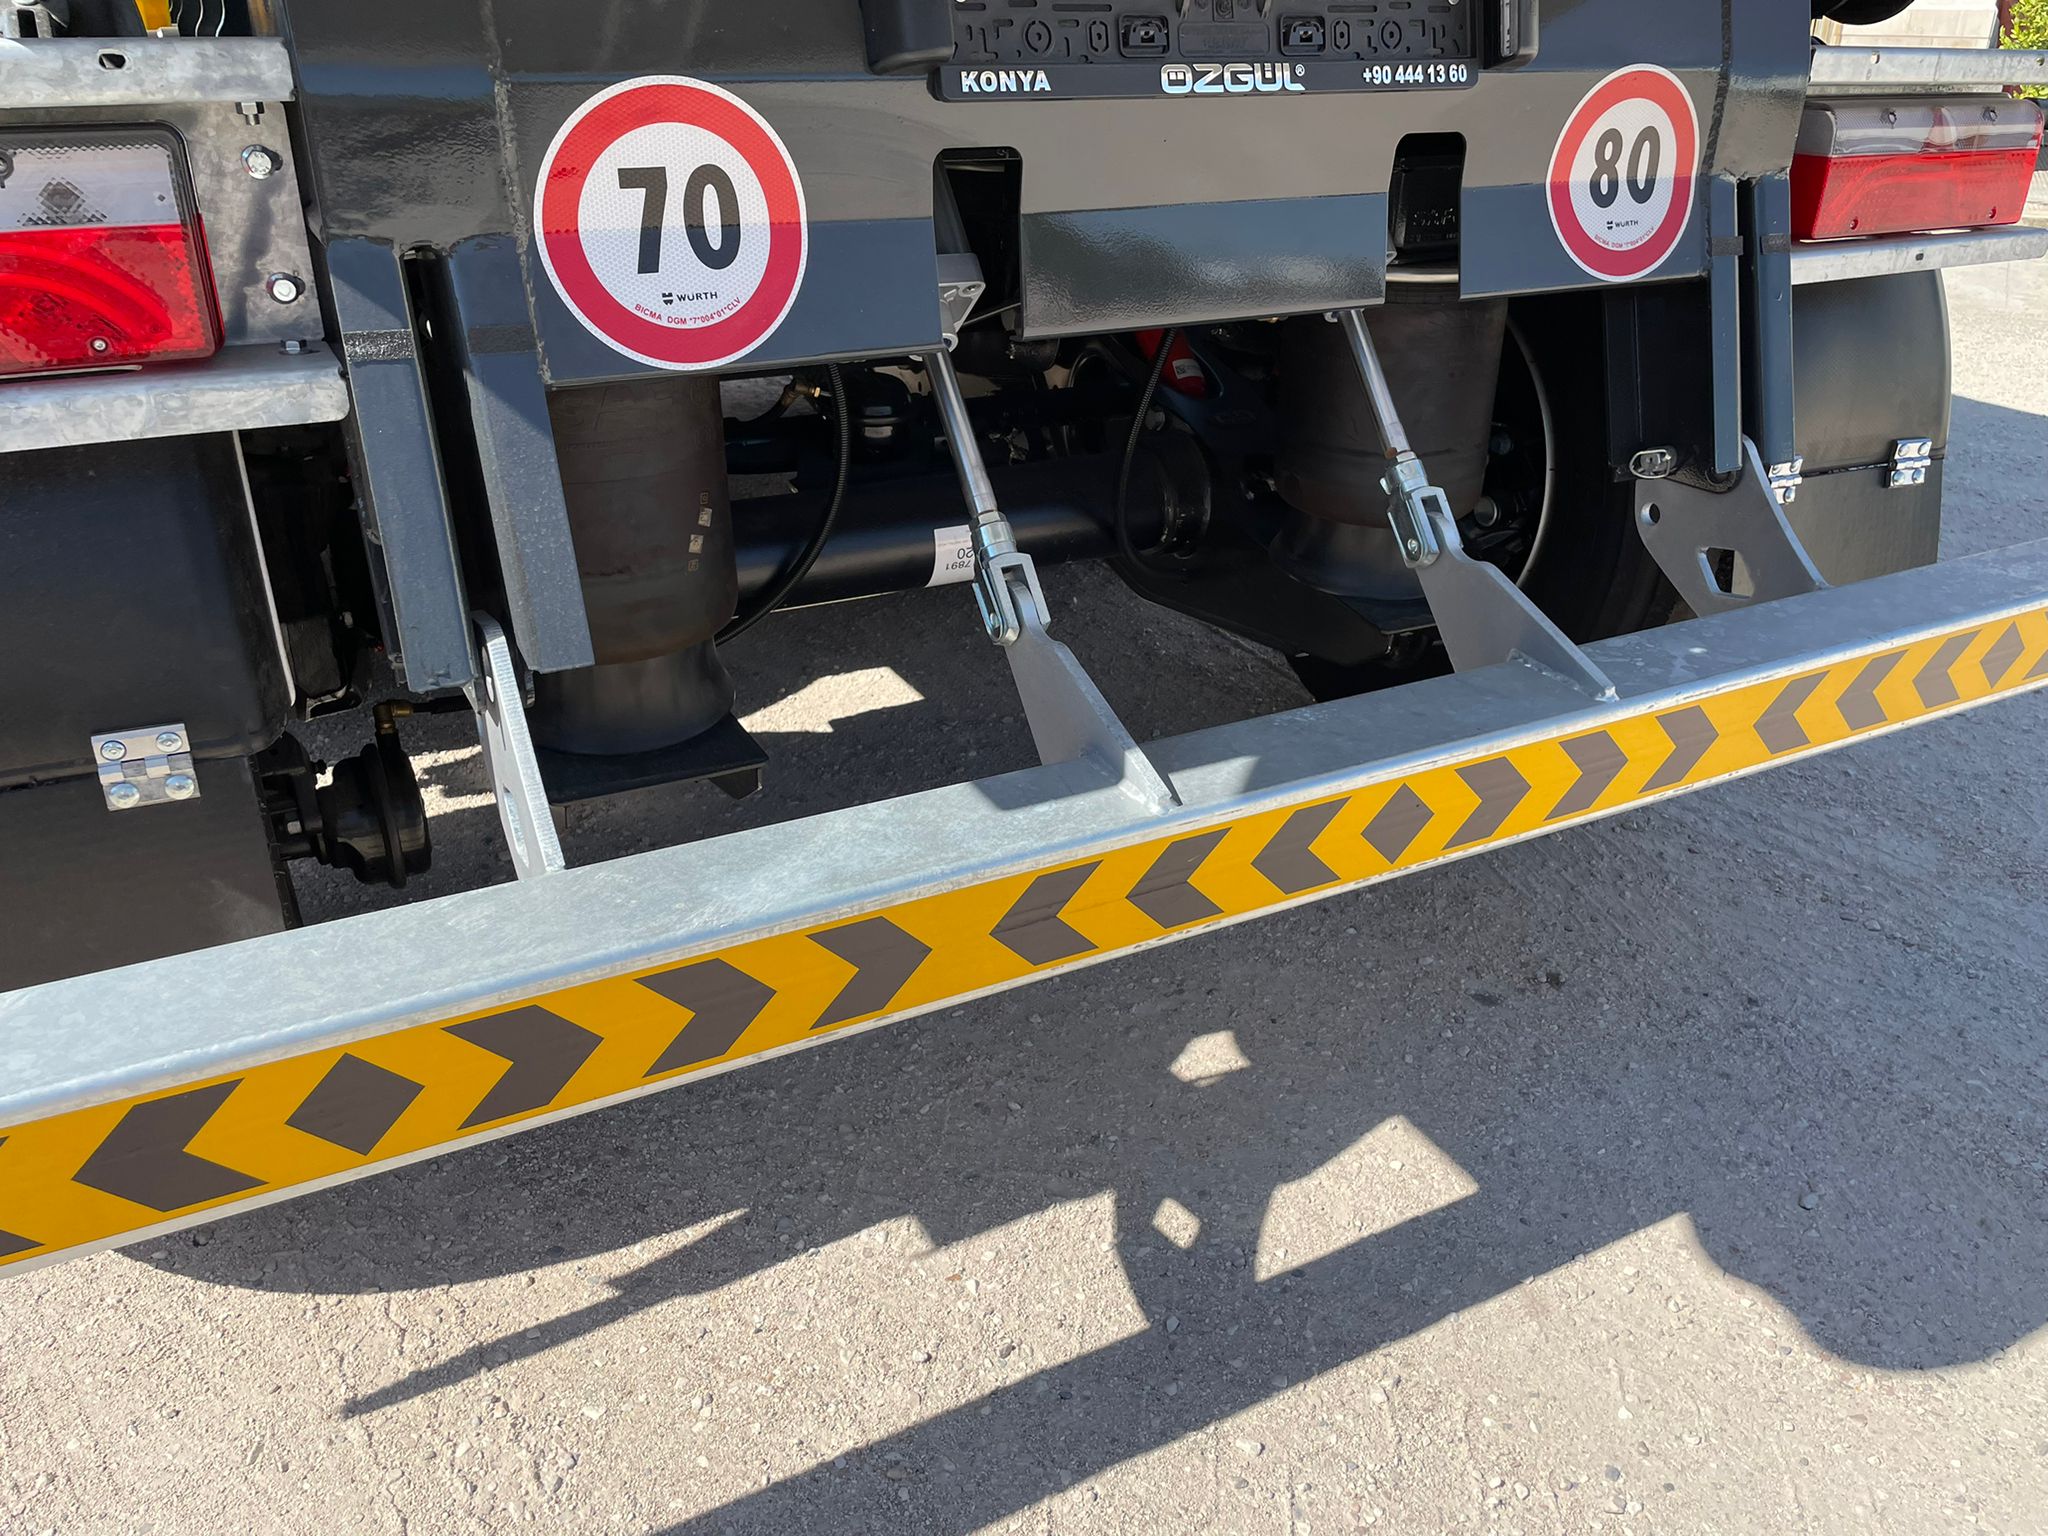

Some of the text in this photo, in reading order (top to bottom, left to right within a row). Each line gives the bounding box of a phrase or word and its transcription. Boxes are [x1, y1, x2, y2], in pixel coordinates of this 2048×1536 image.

[961, 70, 1051, 93] KONYA
[1363, 63, 1467, 84] +90 444 13 60
[1589, 126, 1661, 208] 80
[617, 163, 741, 274] 70
[634, 303, 662, 321] BICMA
[667, 316, 687, 325] DGM
